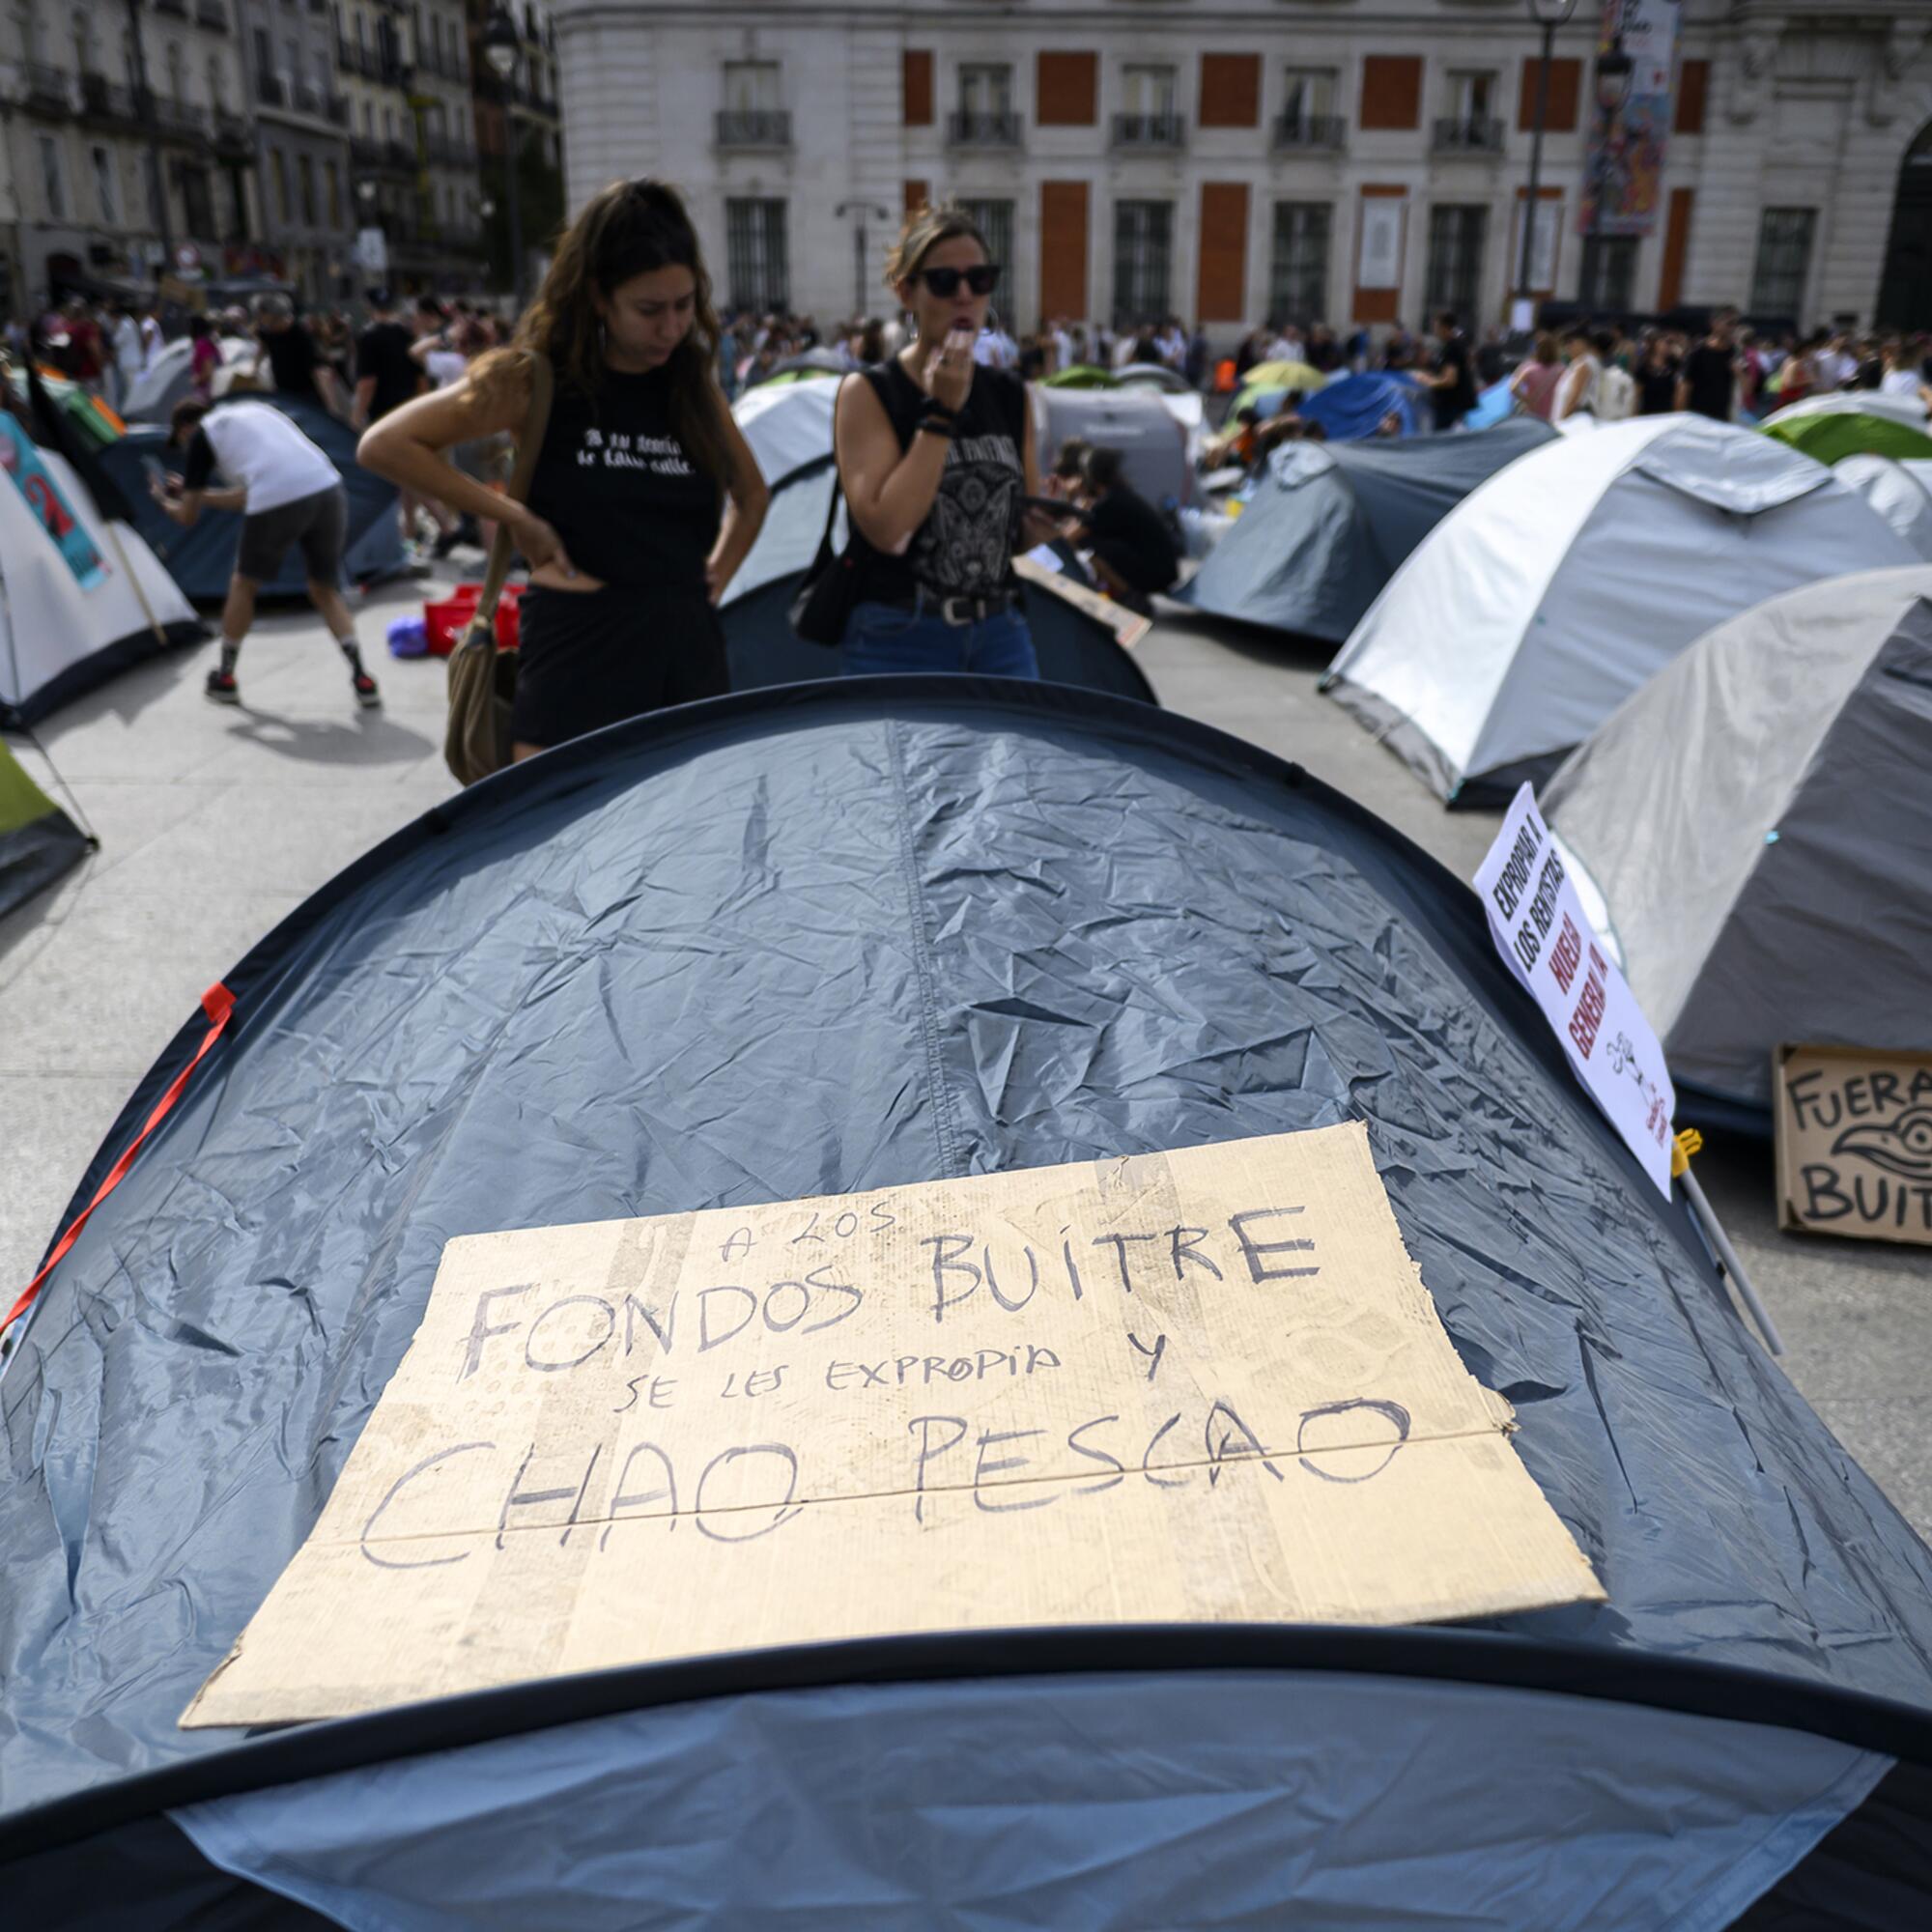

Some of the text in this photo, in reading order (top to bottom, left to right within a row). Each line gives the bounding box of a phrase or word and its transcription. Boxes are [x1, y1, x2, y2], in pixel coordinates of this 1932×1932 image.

[1492, 824, 1538, 923] EXPROPIAR
[1513, 847, 1566, 974] LOS RENTISTAS
[1548, 911, 1582, 996] HUELGA
[719, 1201, 896, 1263] A LOS
[456, 1264, 863, 1385] FONDOS
[612, 1374, 678, 1413] SE
[720, 1364, 789, 1399] LES
[1126, 1332, 1166, 1381] Y
[360, 1397, 1411, 1570] CHAO PESCAO
